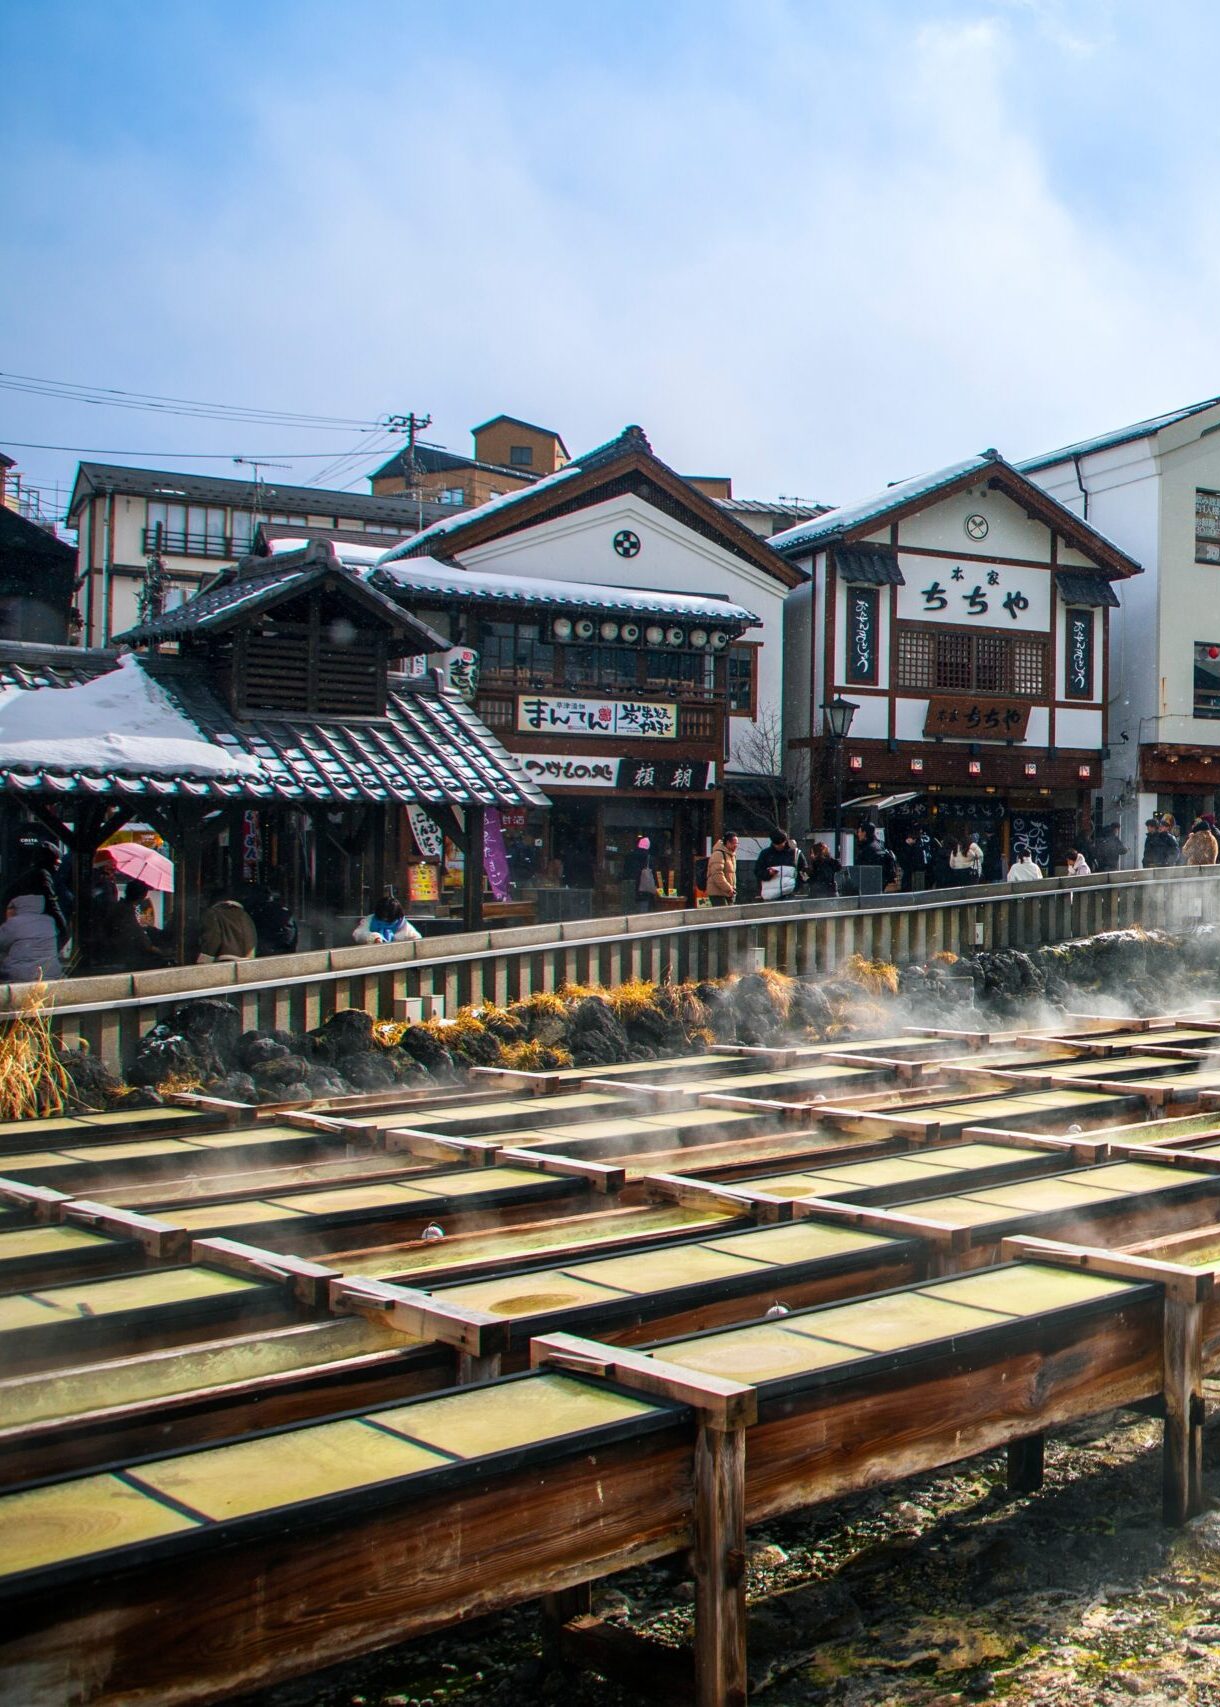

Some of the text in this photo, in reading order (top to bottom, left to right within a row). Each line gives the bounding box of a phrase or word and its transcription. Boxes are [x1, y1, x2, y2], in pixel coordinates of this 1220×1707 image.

[951, 566, 1000, 586] 本家
[921, 581, 1029, 620] ちちや
[522, 698, 609, 731] まんてん
[964, 705, 1021, 731] ちちや
[638, 720, 674, 735] かまど
[514, 757, 613, 781] つけもの処
